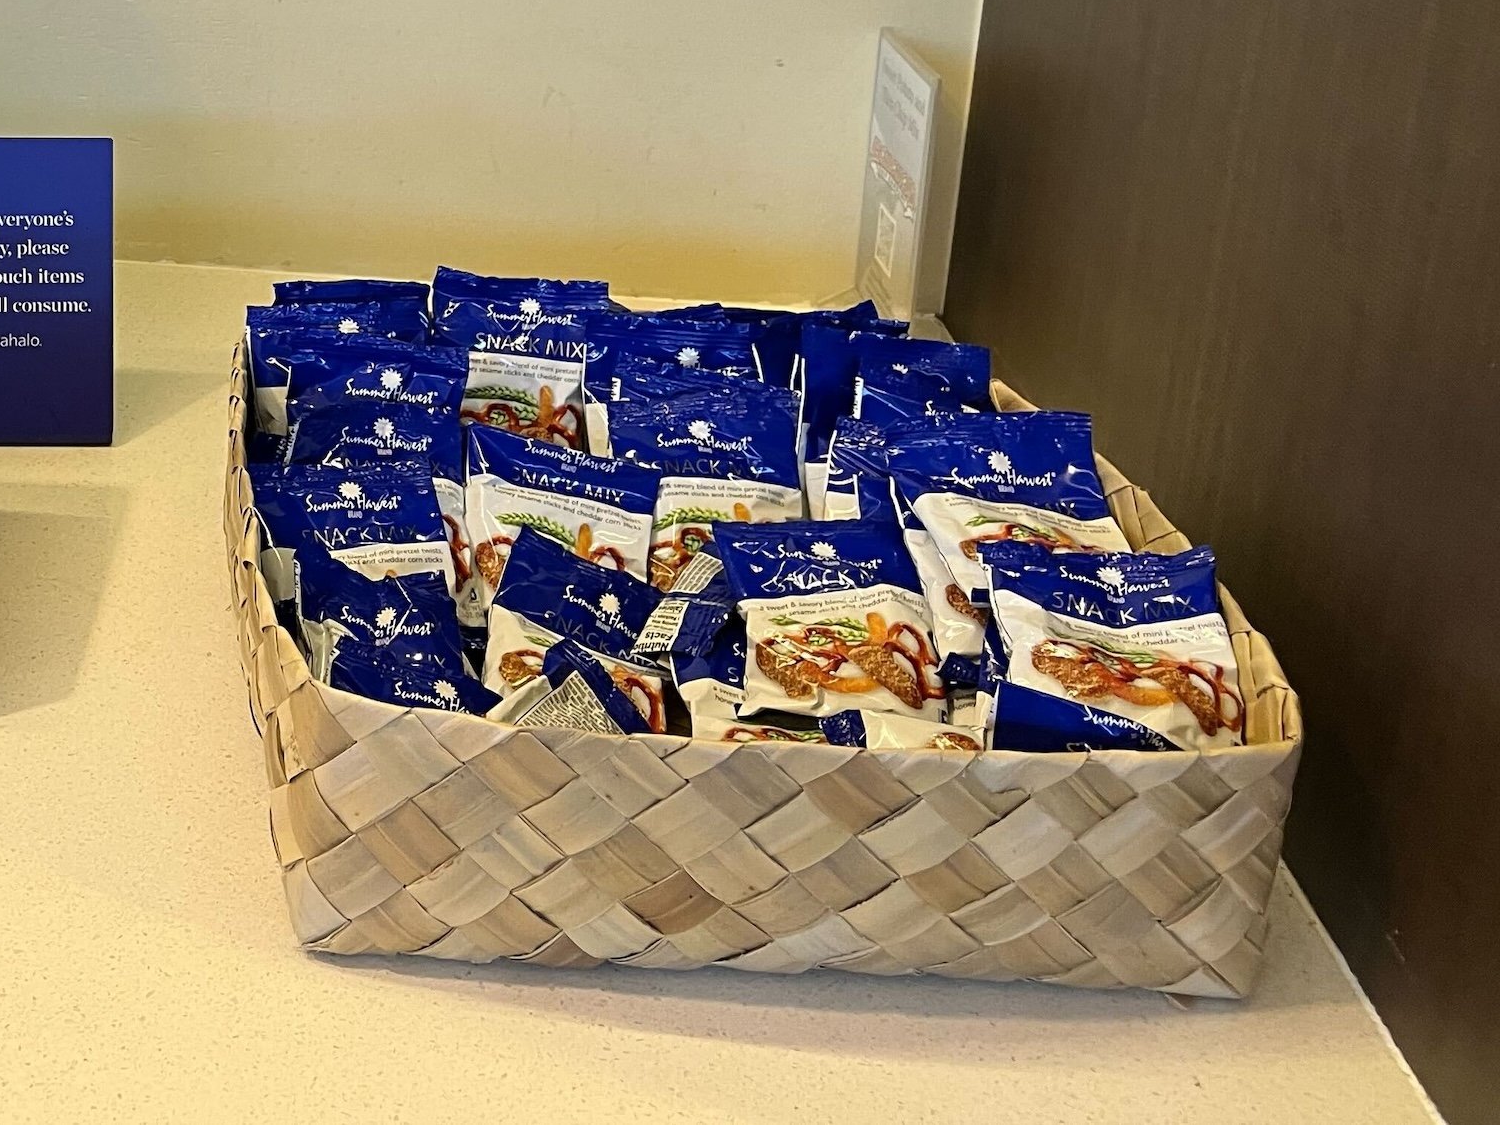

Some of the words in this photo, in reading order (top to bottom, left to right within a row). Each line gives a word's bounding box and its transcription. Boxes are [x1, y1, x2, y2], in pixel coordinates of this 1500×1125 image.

[16, 240, 69, 259] please
[38, 267, 85, 284] items
[12, 298, 92, 313] consume.
[487, 304, 531, 324] Summer
[532, 310, 573, 326] Harvest
[474, 332, 540, 354] SNACK
[546, 339, 584, 359] MIX
[345, 378, 390, 399] Summer
[393, 386, 434, 404] Harvest
[340, 426, 384, 448] Summer
[386, 433, 428, 452] Harvest
[657, 433, 705, 453] Summer
[706, 435, 748, 451] Harvest
[525, 438, 572, 463] Summer
[574, 453, 620, 473] Harvest
[951, 467, 1005, 486] Summer
[1007, 469, 1053, 486] Harvest
[306, 494, 355, 513] Summer
[357, 493, 399, 512] Harvest
[1059, 565, 1115, 595] Summer
[563, 584, 606, 621] Summer
[608, 613, 638, 640] Harve
[1052, 592, 1138, 625] SNACK
[1143, 594, 1198, 620] MIX
[386, 619, 431, 637] Harvest
[645, 632, 673, 640] Facts
[634, 642, 669, 652] Nutritio
[394, 681, 446, 709] Summer
[1083, 705, 1145, 734] Summer
